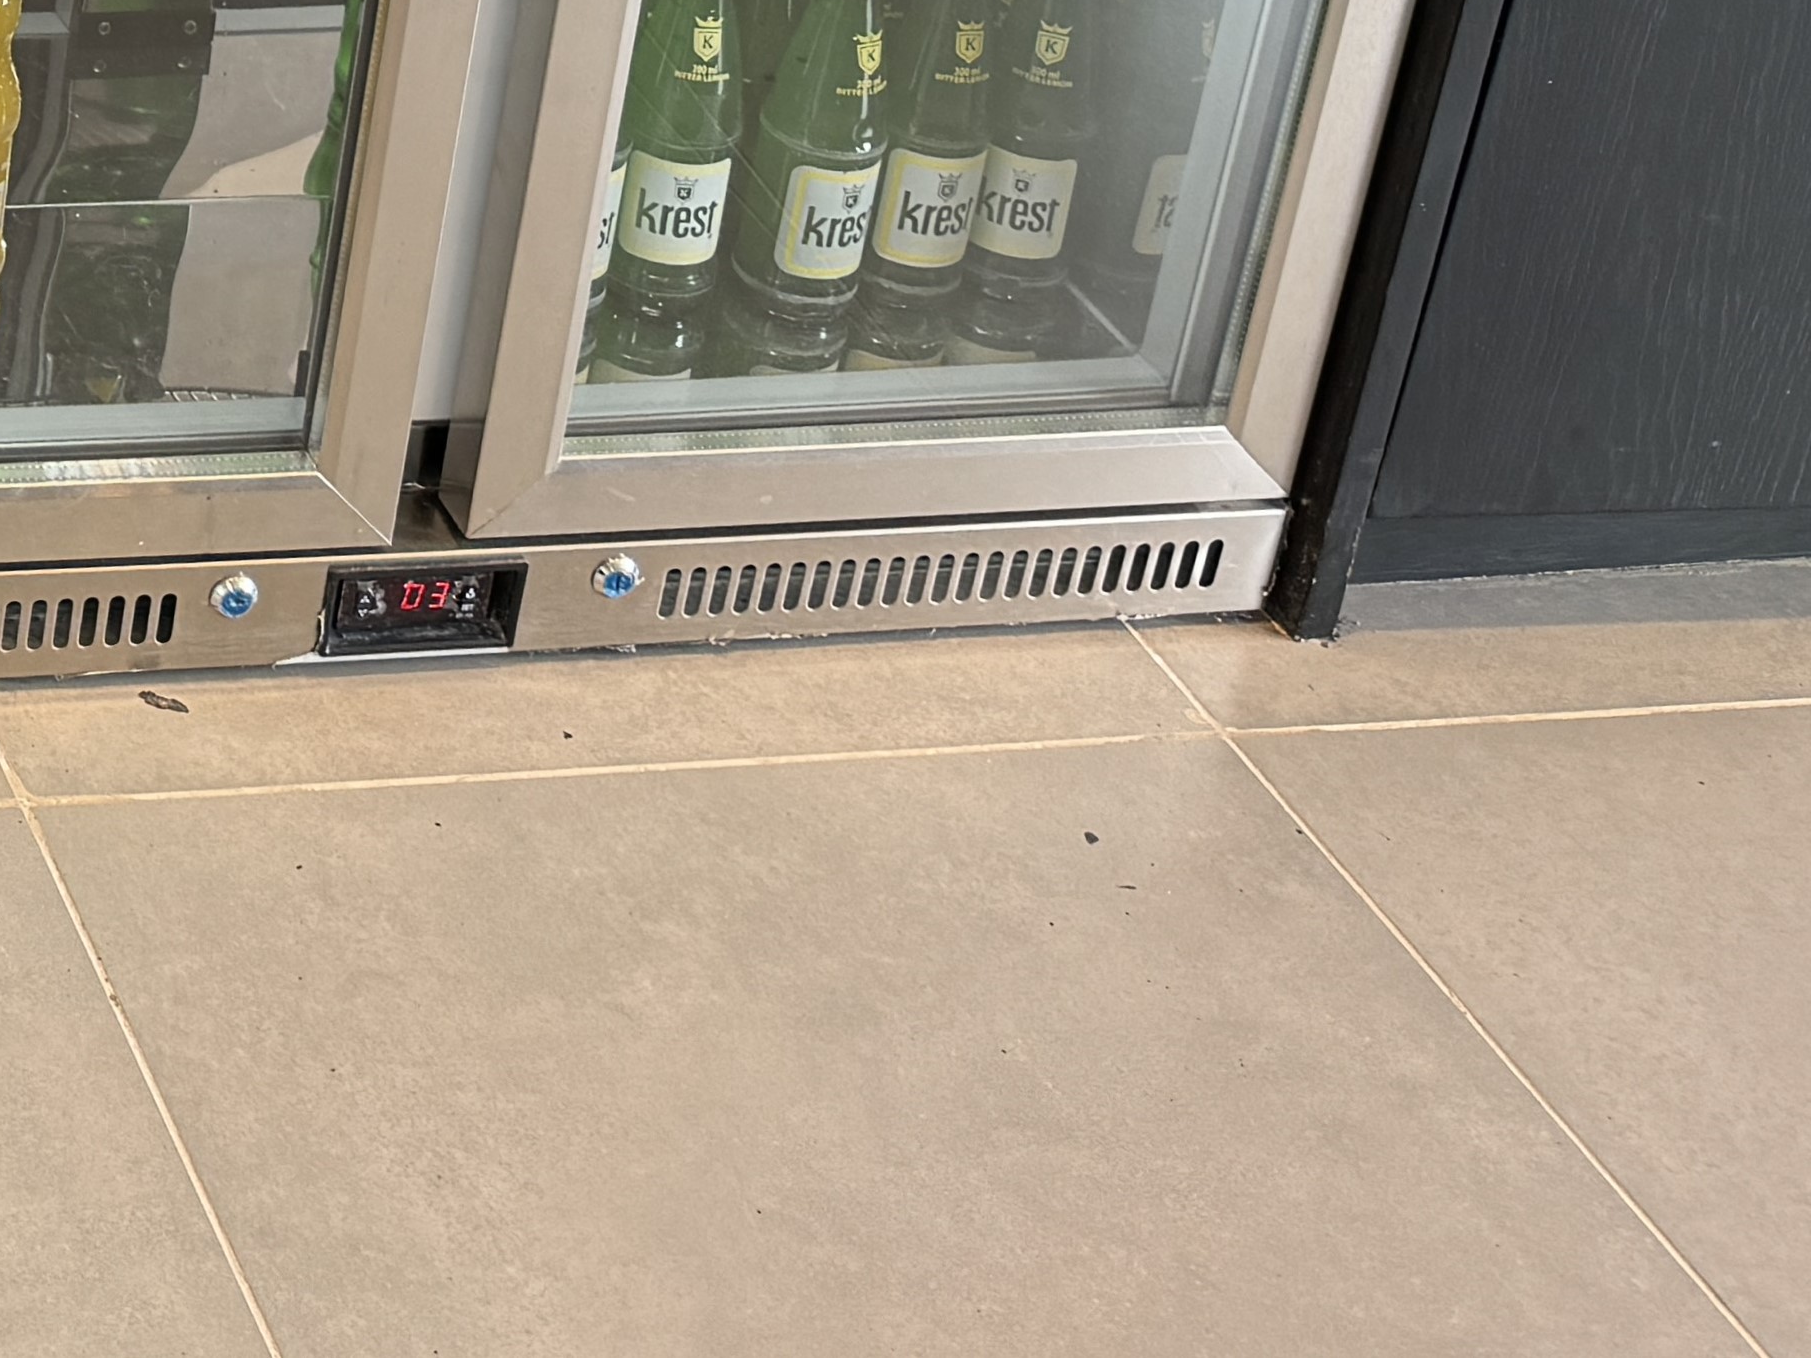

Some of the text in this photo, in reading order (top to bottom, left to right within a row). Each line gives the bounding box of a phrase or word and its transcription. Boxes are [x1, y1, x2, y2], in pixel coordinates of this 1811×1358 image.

[701, 35, 713, 50] K
[964, 37, 976, 52] K
[1043, 39, 1057, 55] K
[866, 48, 877, 63] K
[634, 188, 716, 239] krest
[979, 188, 1059, 235] krest
[801, 205, 865, 249] kres
[399, 581, 452, 611] 03
